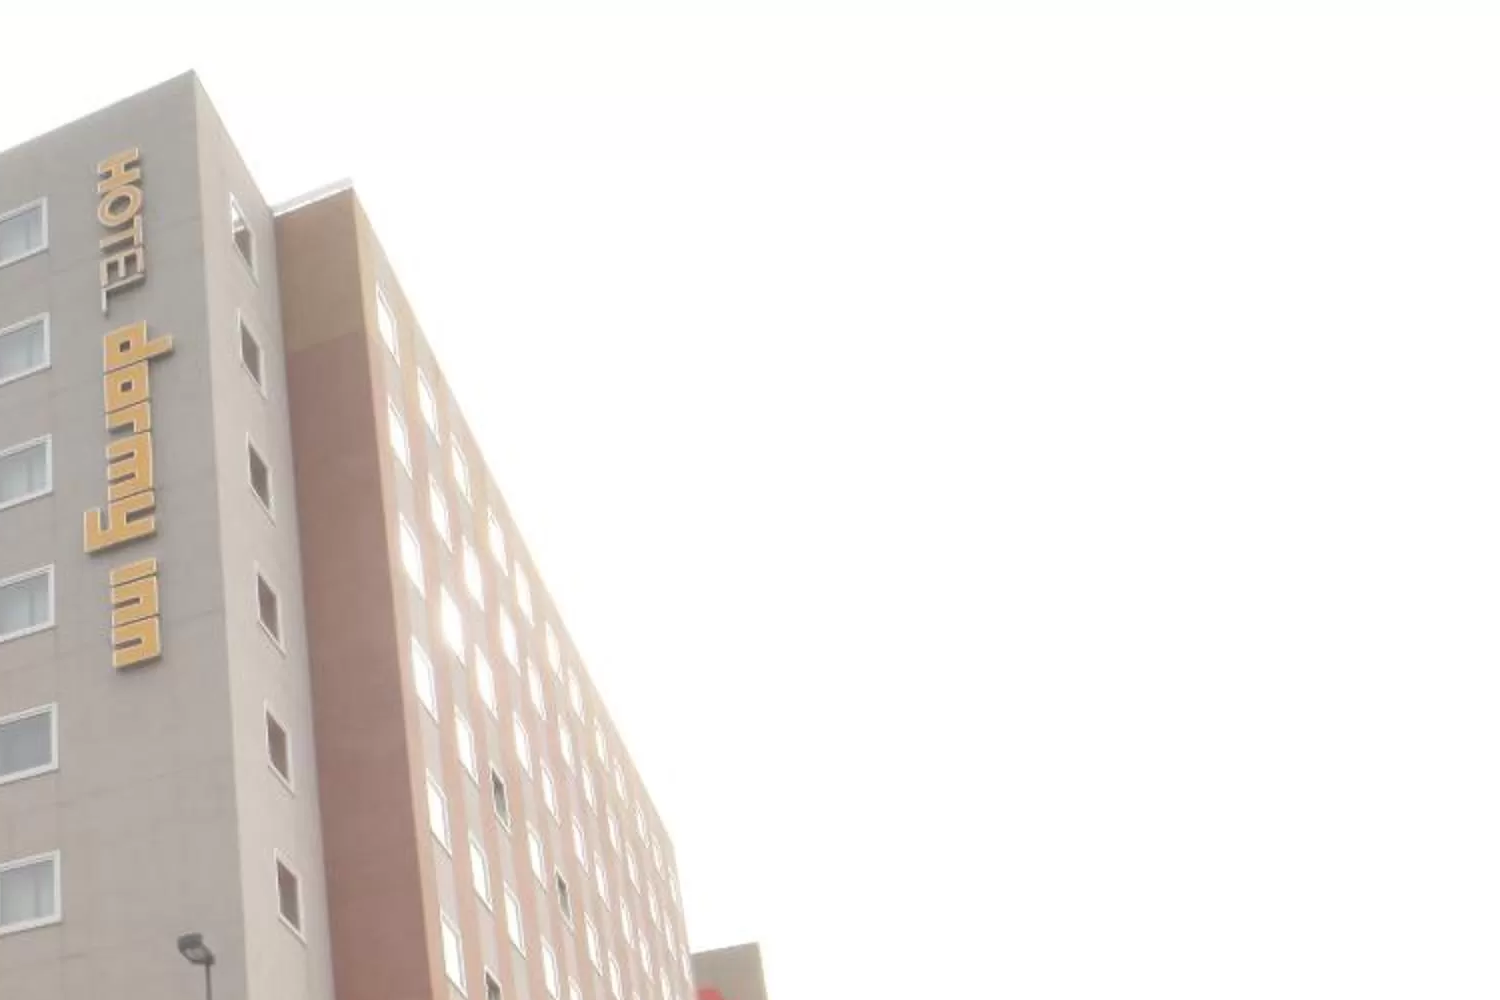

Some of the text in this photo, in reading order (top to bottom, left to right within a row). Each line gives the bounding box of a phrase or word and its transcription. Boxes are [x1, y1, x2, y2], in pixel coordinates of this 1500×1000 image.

[96, 147, 147, 317] HOTEL
[83, 319, 174, 670] dormy inn
